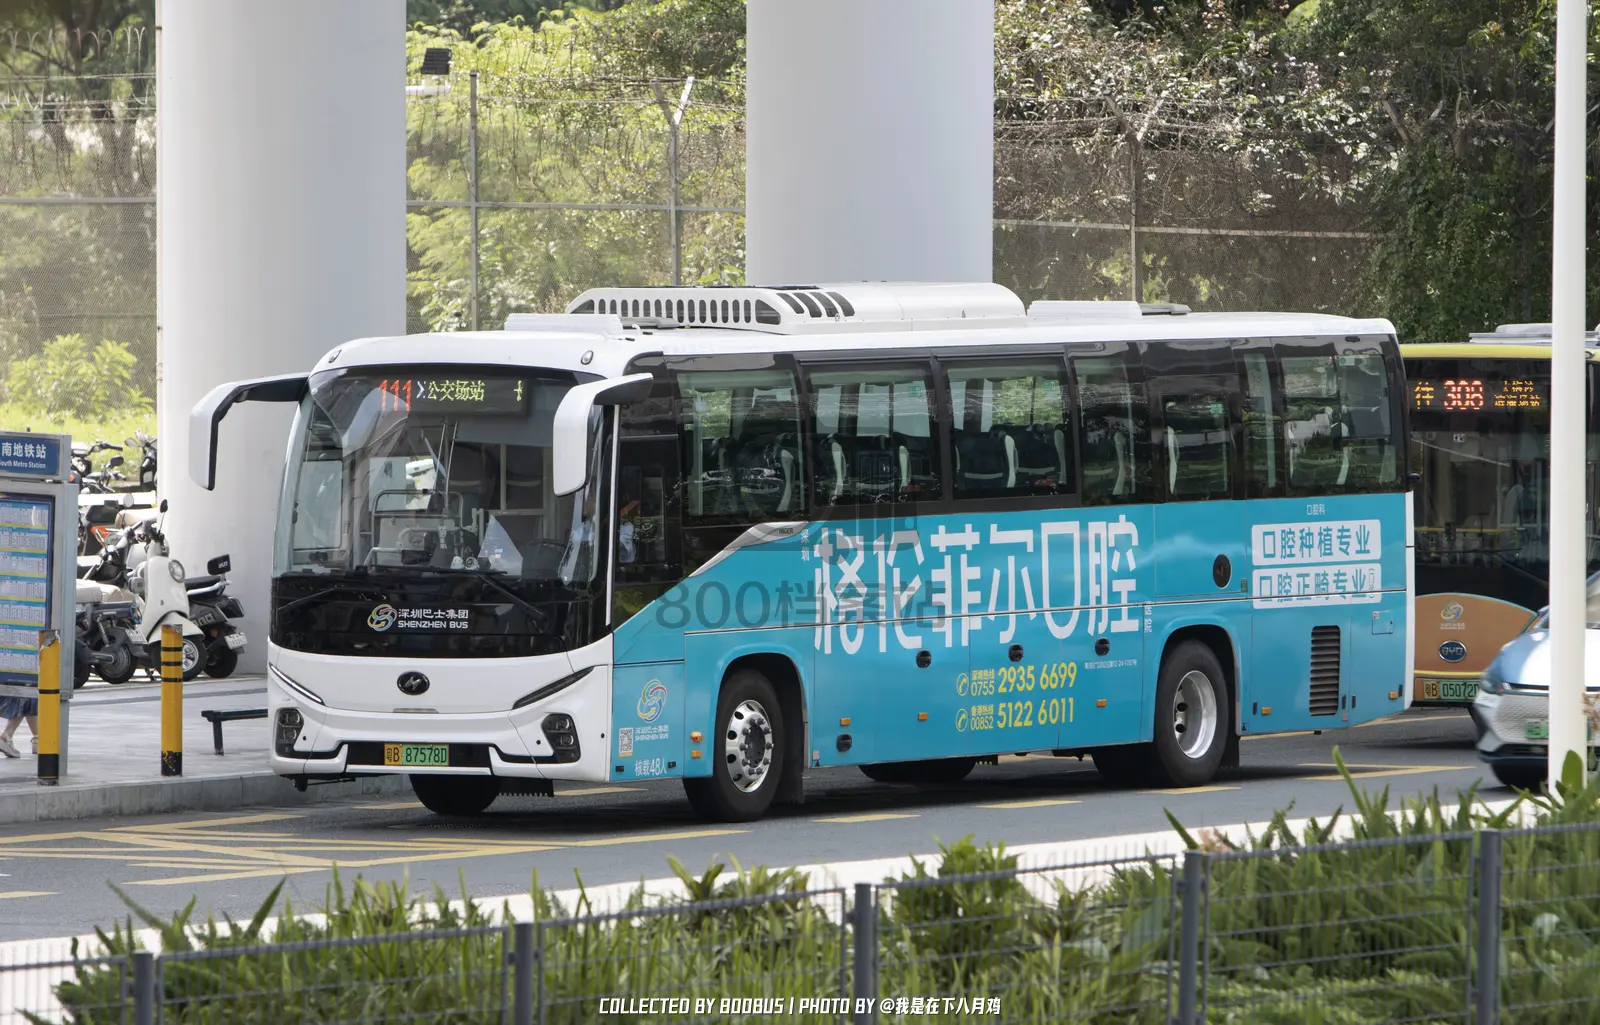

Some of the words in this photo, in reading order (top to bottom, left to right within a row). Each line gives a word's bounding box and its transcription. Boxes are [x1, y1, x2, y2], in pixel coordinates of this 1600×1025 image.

[378, 380, 412, 411] 111
[427, 380, 485, 401] 公交场站
[1443, 380, 1484, 410] 308
[1, 442, 47, 459] 南地铁站
[1306, 504, 1326, 516] 口腔科
[1262, 524, 1371, 559] 口腔种植专业
[814, 514, 1139, 655] 格伦菲尔口腔
[1259, 568, 1367, 603] 口腔正畸专业
[398, 608, 469, 619] 深圳巴士集团
[398, 620, 447, 628] SHENZHEN
[449, 621, 468, 629] BUS
[1441, 646, 1464, 656] BYD
[970, 681, 995, 696] 0755
[998, 665, 1035, 693] 2935
[1040, 661, 1077, 690] 6699
[970, 715, 994, 731] 00852
[997, 700, 1032, 728] 5122
[1038, 697, 1074, 725] 6011
[634, 758, 667, 776] 核载48人
